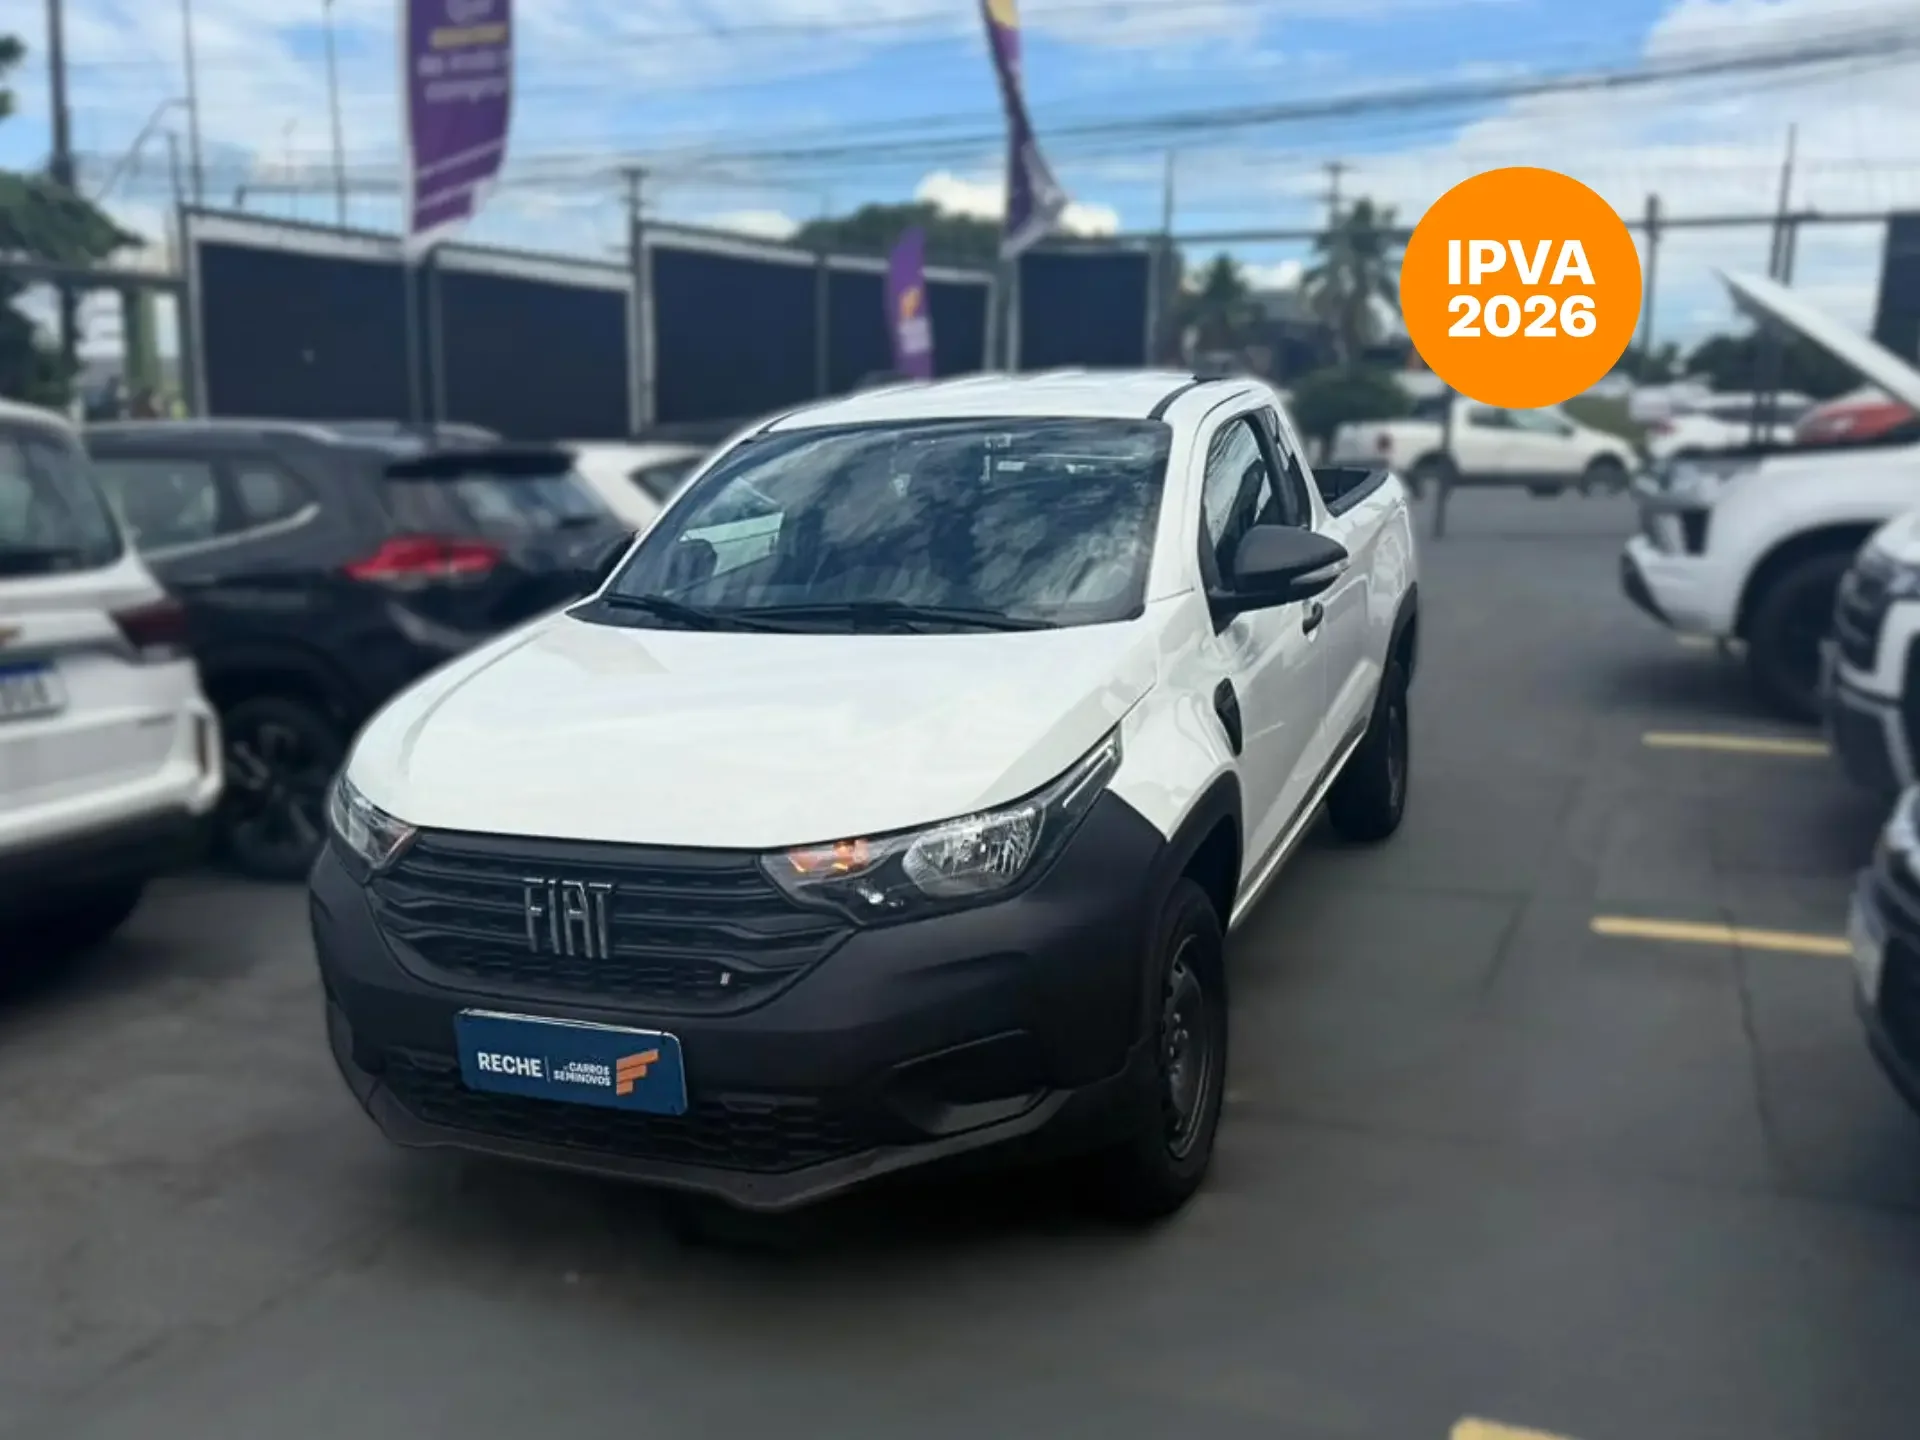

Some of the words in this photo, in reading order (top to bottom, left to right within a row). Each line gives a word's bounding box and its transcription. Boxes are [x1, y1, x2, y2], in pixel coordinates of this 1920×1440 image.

[523, 876, 612, 960] FIAT
[477, 1052, 544, 1078] RECHE
[569, 1061, 610, 1076] CARROS
[553, 1070, 612, 1087] SEMINOVOS
